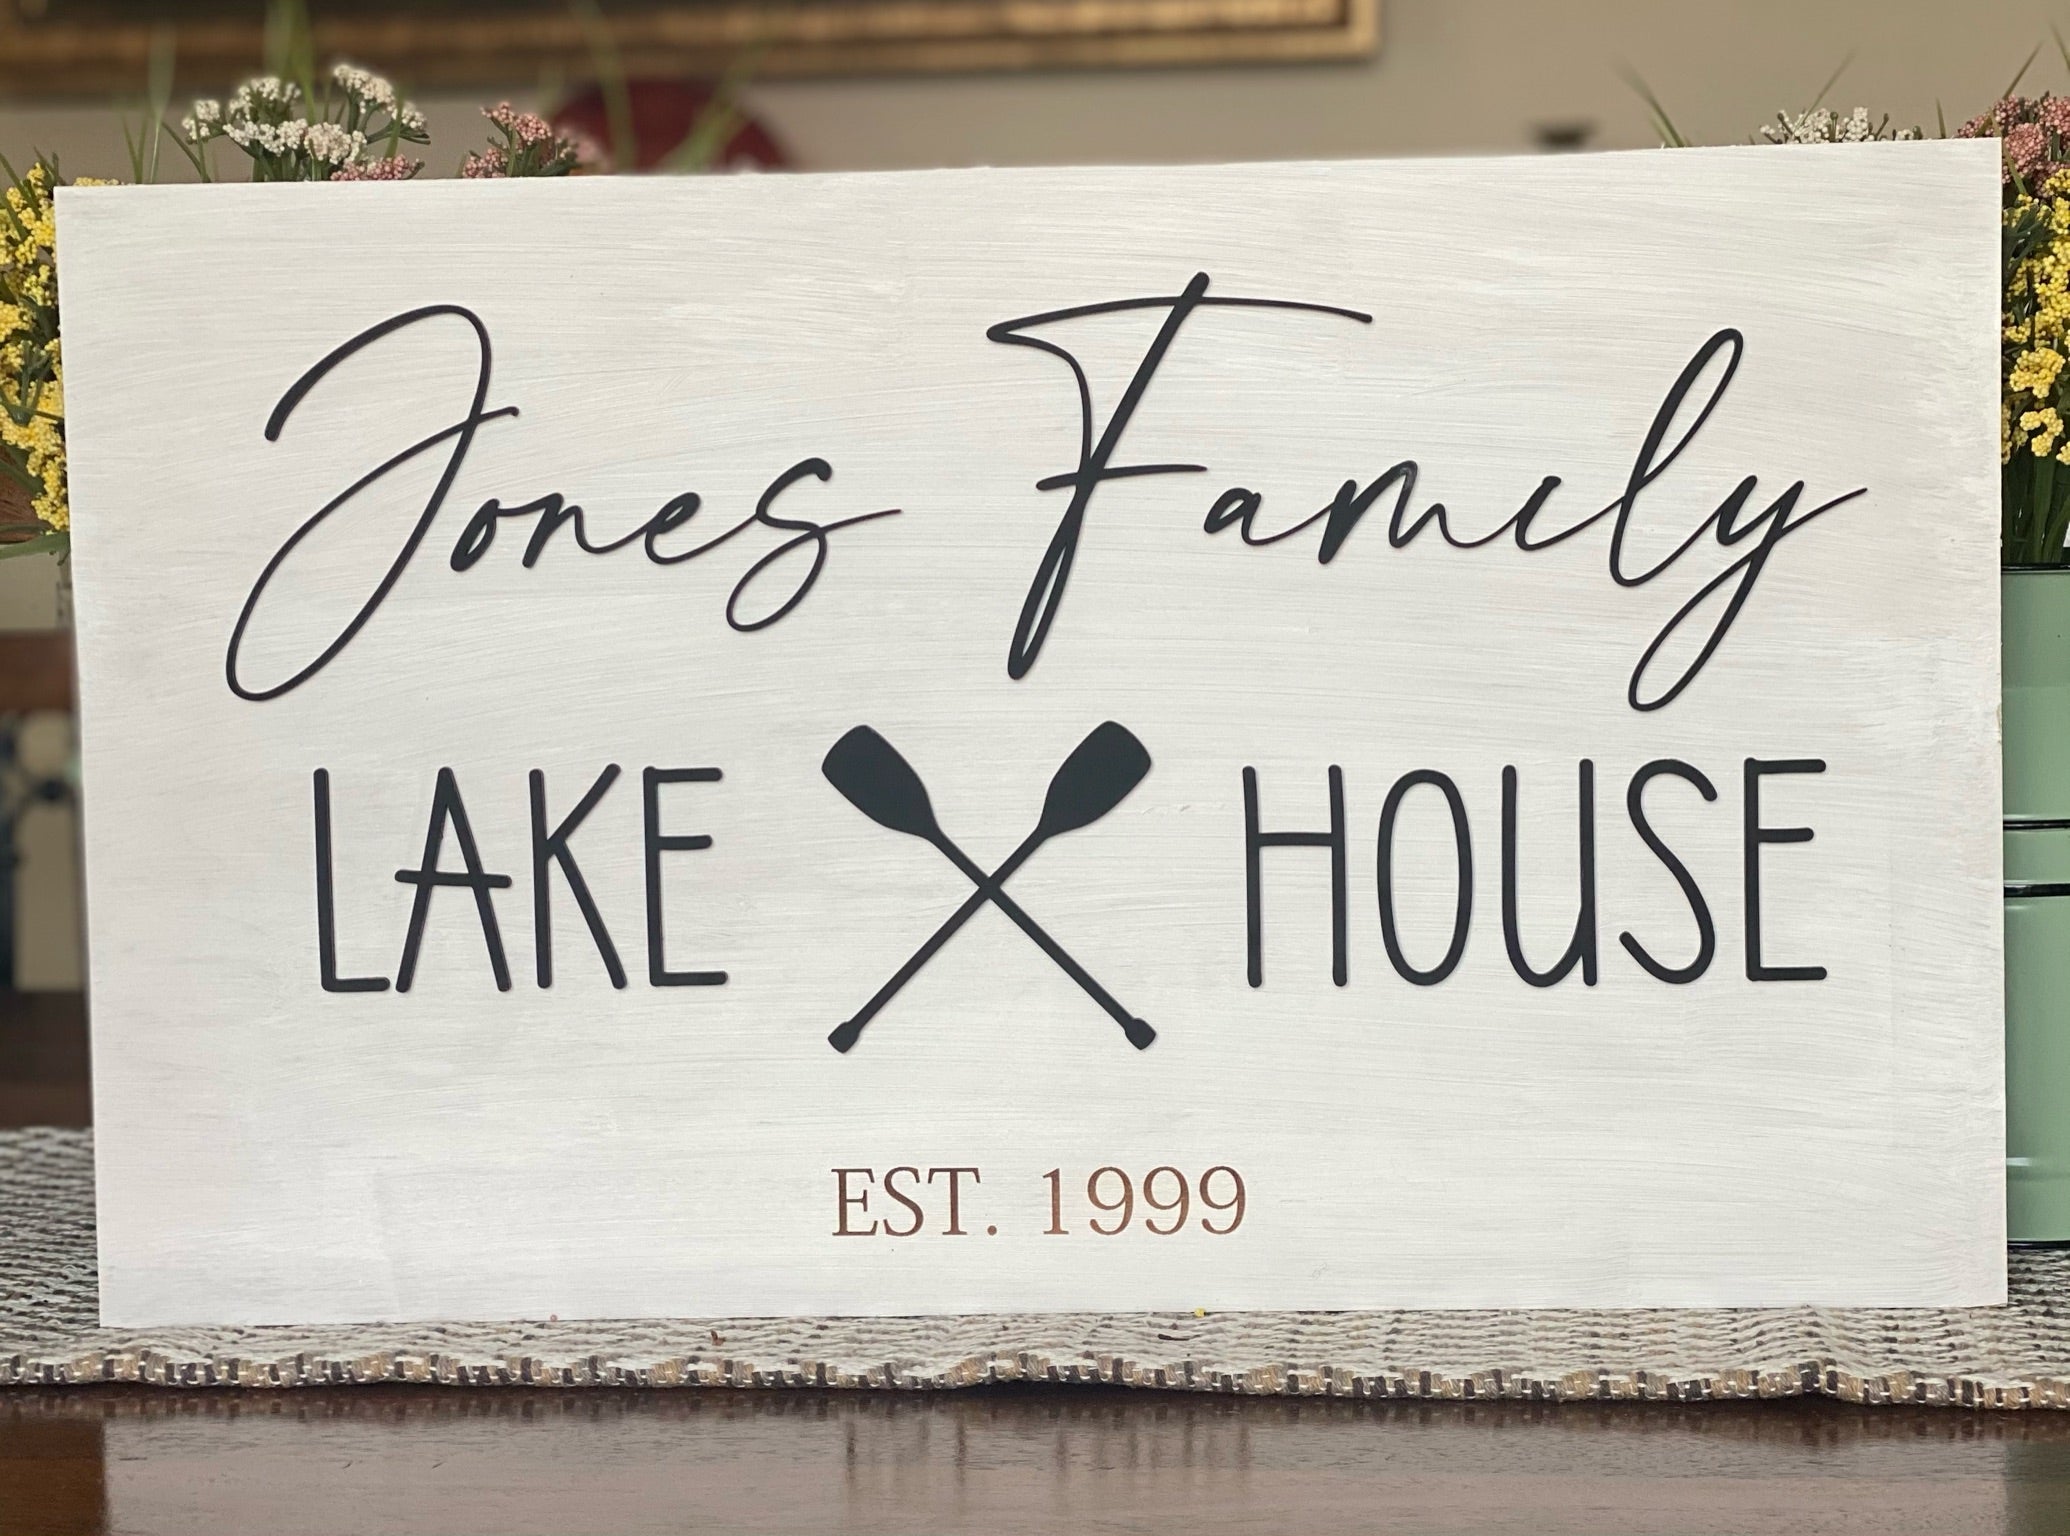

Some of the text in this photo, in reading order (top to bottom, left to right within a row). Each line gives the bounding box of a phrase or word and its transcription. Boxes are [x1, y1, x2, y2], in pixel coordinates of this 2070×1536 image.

[225, 271, 1869, 713] Jones Family
[313, 757, 1828, 994] LAKE HOUSE
[830, 1165, 1247, 1237] EST. 1999
